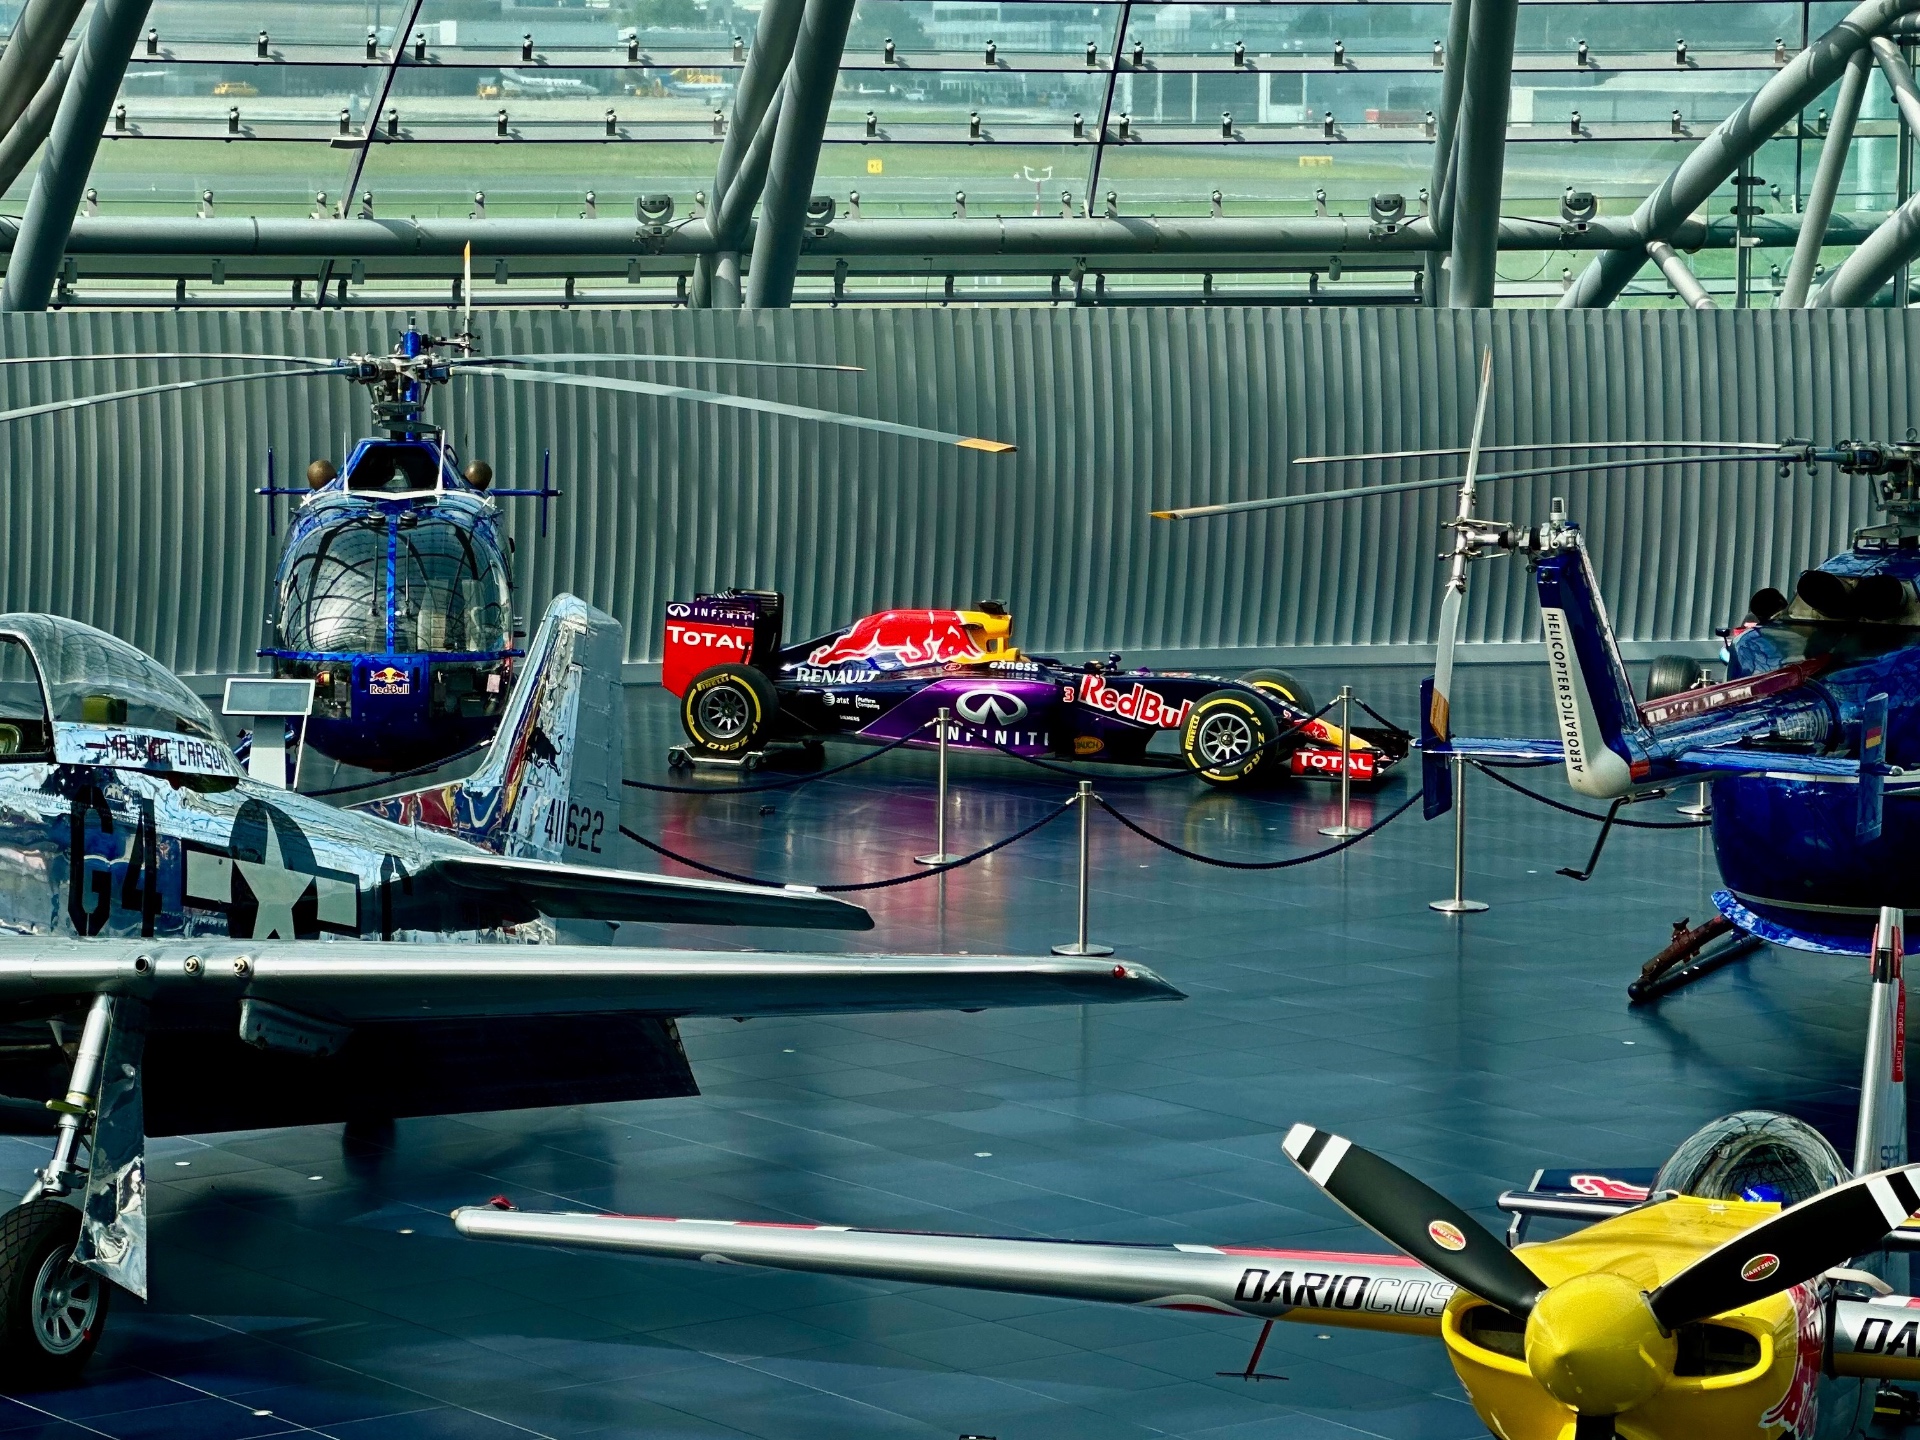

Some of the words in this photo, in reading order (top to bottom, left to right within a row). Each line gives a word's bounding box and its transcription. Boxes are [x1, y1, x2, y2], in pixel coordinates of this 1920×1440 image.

[666, 625, 752, 651] TOTAL
[1547, 613, 1570, 691] HELICOPTER
[795, 667, 881, 685] RENAULT
[989, 661, 1039, 672] exness
[1063, 686, 1075, 703] 3
[1077, 674, 1196, 728] RedBul
[706, 735, 749, 752] ZERO
[935, 724, 1049, 747] INFINITI
[1560, 694, 1584, 773] AEROBATICS
[1243, 731, 1265, 775] ZRO
[1296, 751, 1374, 771] TOTAL
[544, 798, 605, 854] 411622
[1744, 1259, 1777, 1278] HARTZELL
[1365, 1278, 1457, 1317] COS
[1853, 1317, 1920, 1358] DA
